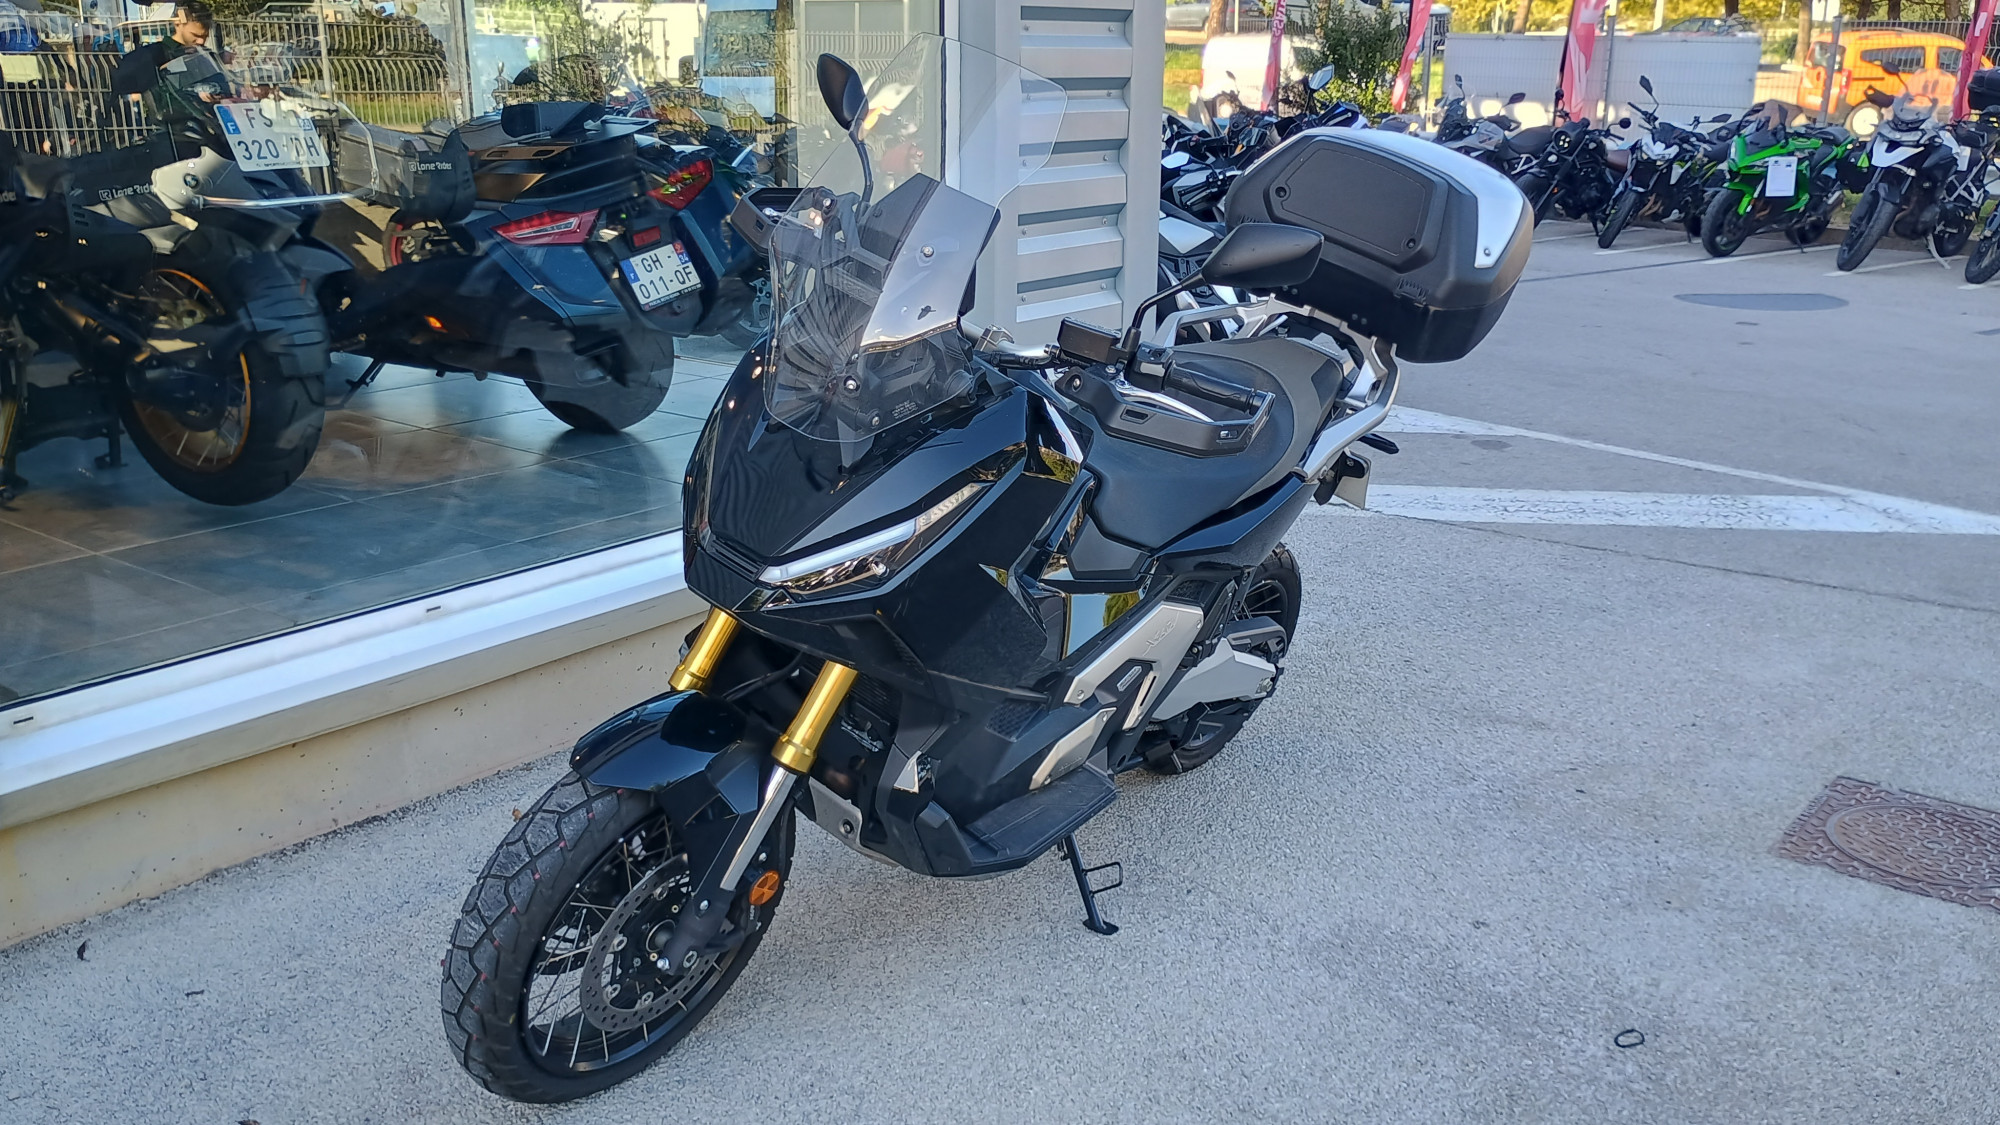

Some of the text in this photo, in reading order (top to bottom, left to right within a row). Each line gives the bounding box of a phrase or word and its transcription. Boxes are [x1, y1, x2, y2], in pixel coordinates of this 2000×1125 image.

[244, 108, 273, 128] FS
[227, 122, 236, 133] F
[417, 162, 436, 170] Lone
[639, 266, 692, 299] 011-QF
